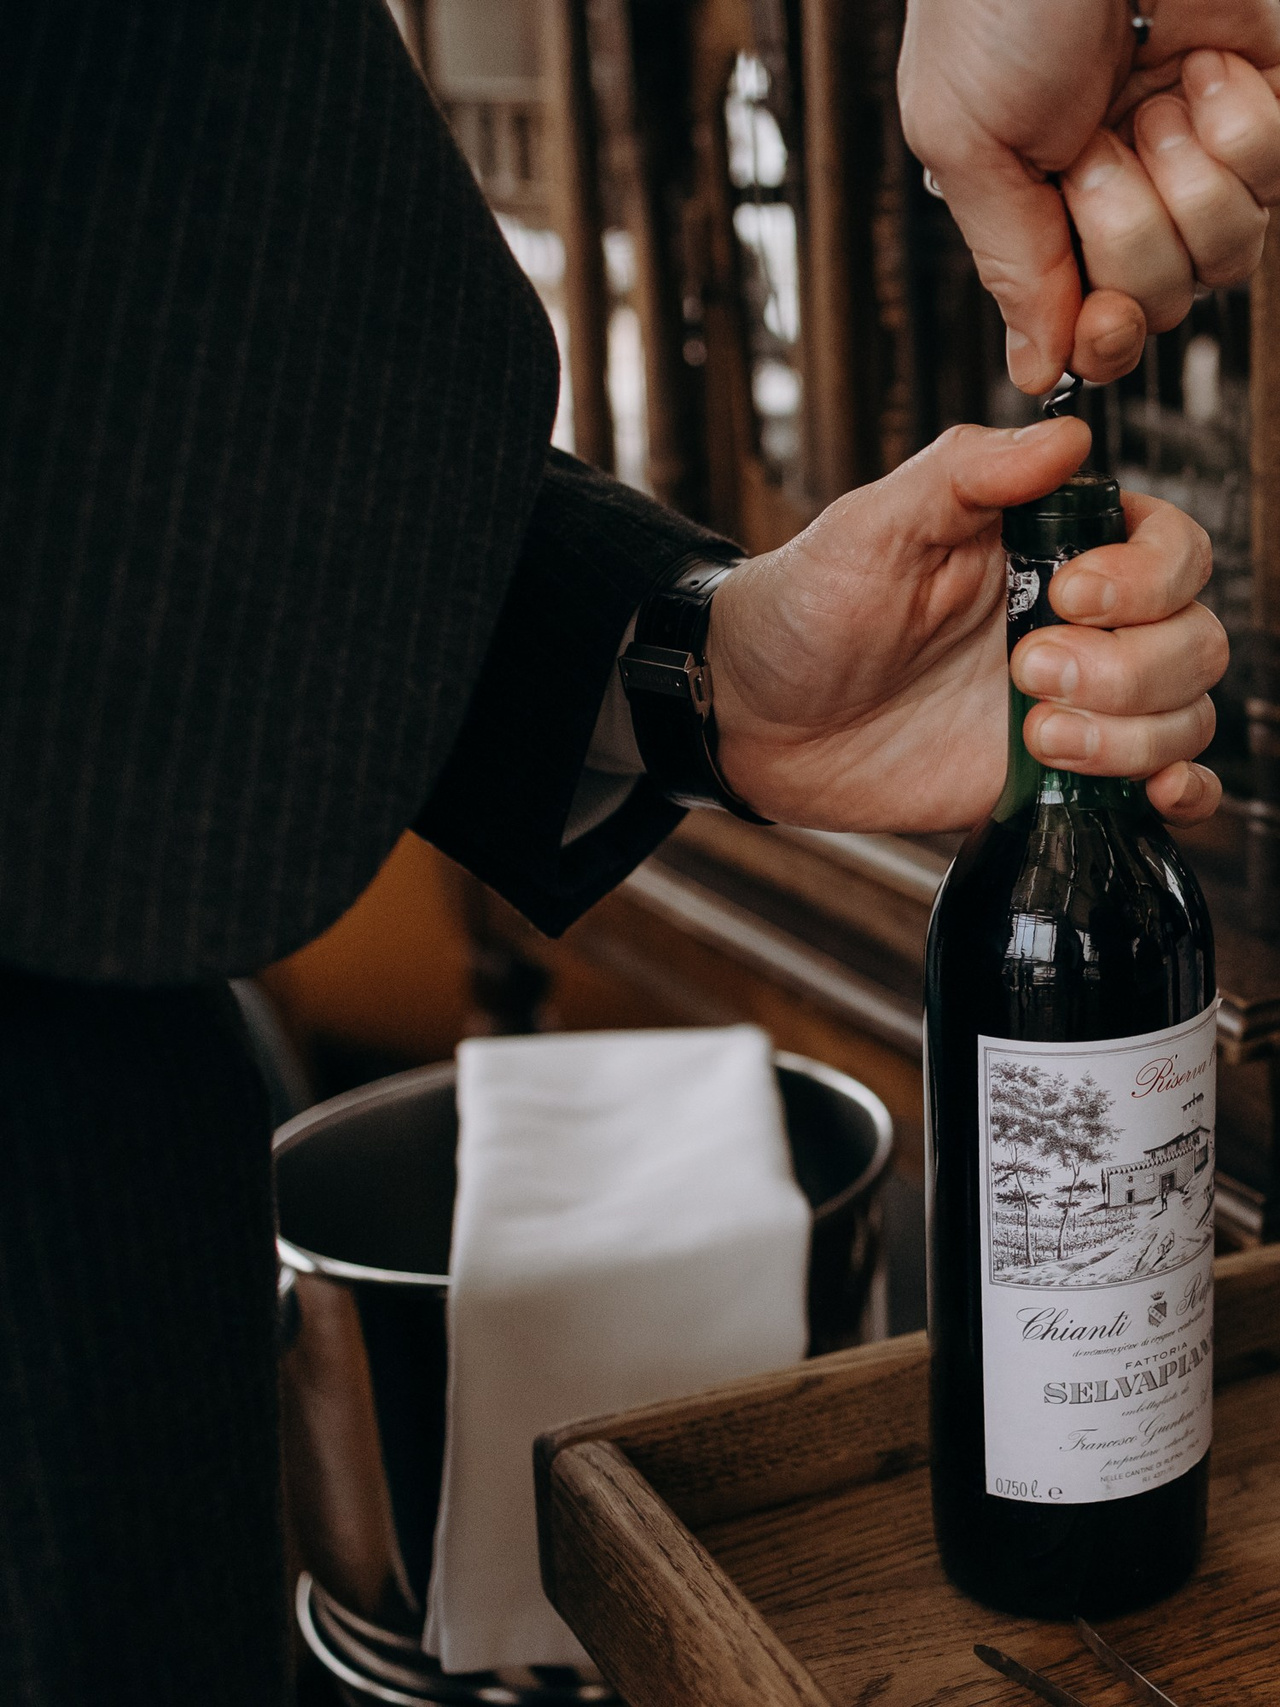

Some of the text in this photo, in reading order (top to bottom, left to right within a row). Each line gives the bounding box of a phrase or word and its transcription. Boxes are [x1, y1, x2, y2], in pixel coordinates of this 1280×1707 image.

[1131, 1054, 1207, 1099] Riserva
[1015, 1306, 1133, 1342] Chianti
[1125, 1341, 1188, 1370] FATTORIA
[1059, 1428, 1138, 1452] Francesco
[1125, 1464, 1154, 1478] CANTINE
